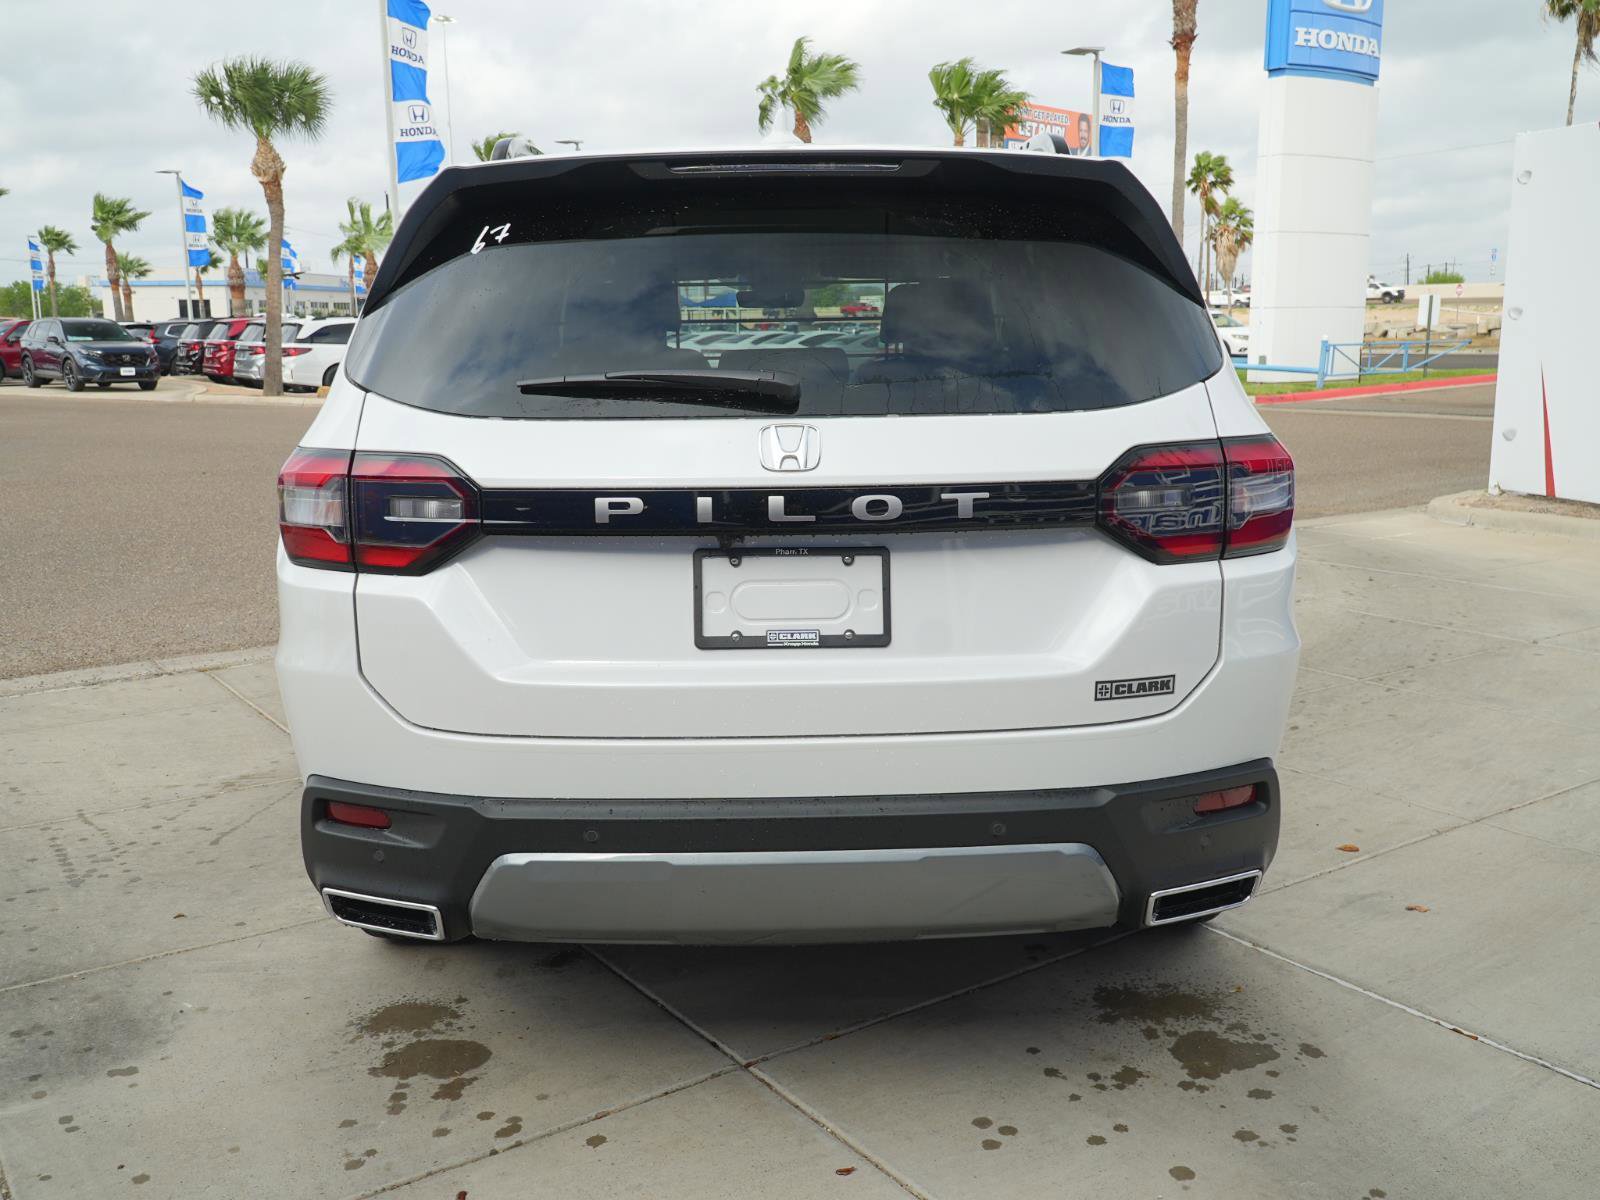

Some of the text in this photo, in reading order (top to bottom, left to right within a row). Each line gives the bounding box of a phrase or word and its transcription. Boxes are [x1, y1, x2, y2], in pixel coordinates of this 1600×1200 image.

[1294, 27, 1380, 59] HONDA
[391, 45, 425, 64] HONDA
[1103, 115, 1131, 123] HONDA
[594, 491, 990, 523] PILOT
[778, 632, 817, 640] CLARK
[1114, 679, 1172, 695] CLARK
